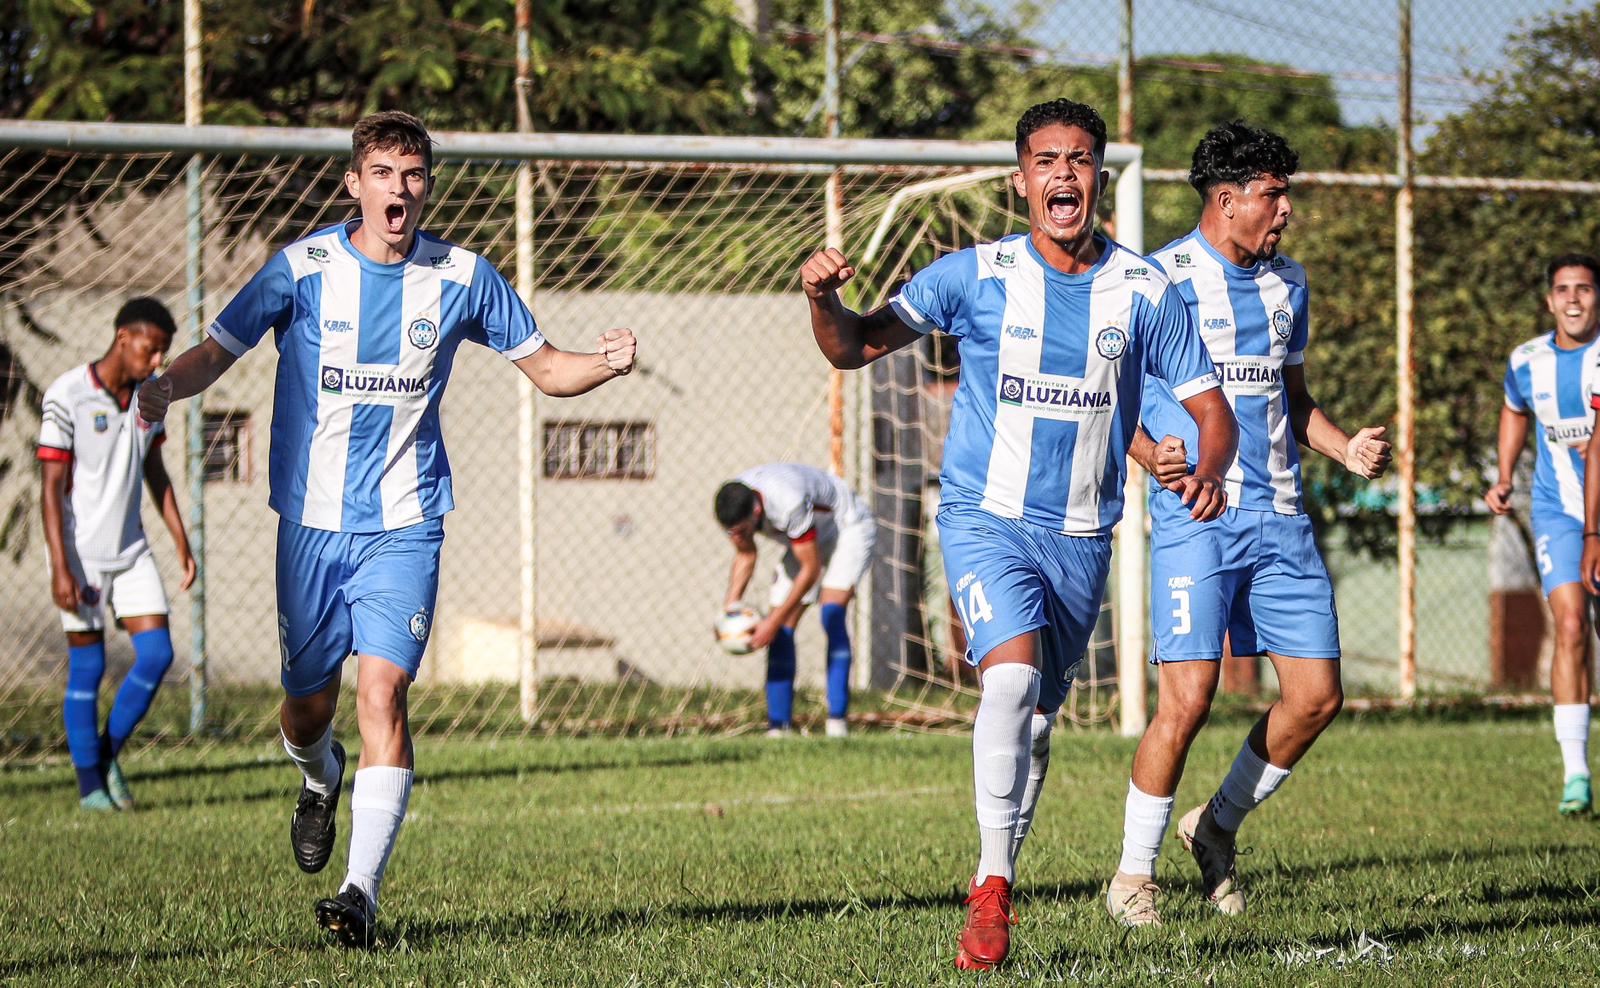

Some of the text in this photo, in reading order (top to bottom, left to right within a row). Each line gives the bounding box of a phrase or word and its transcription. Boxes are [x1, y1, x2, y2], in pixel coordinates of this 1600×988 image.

[345, 375, 426, 393] LUZIÂNIA
[1027, 379, 1069, 388] PREFEITURA
[1026, 385, 1112, 408] LUZIÂNIA
[958, 580, 993, 641] 14
[1171, 590, 1191, 635] 3
